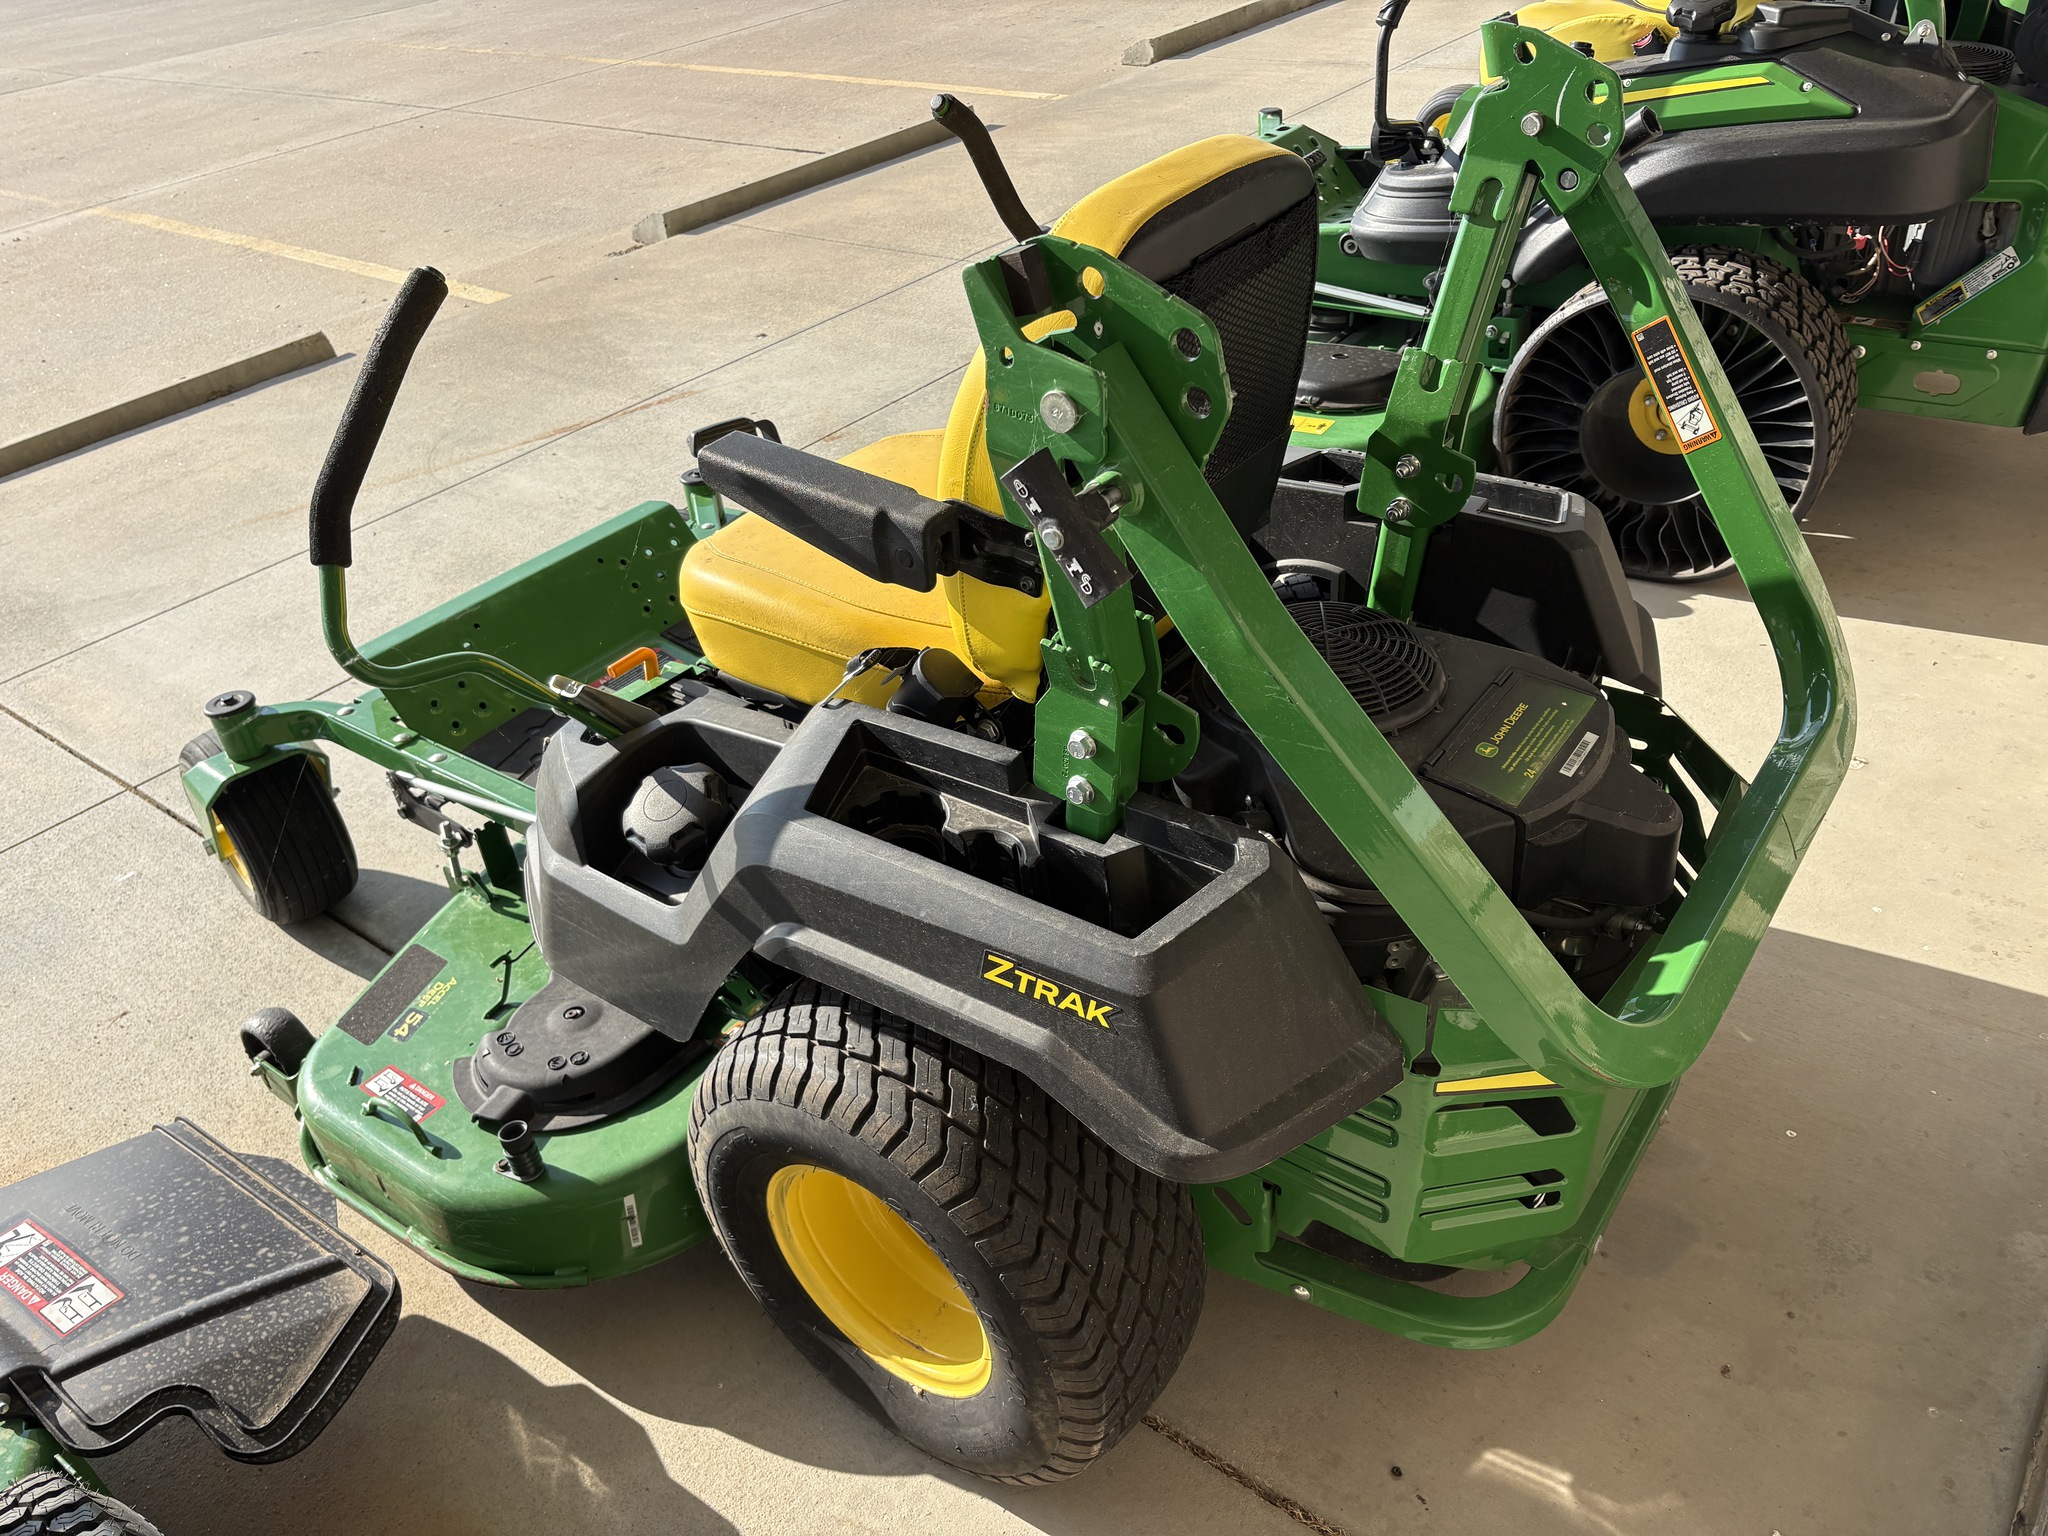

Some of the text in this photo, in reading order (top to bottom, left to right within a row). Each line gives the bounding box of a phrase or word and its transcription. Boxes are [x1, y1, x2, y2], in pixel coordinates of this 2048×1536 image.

[1686, 392, 1700, 403] AVOID
[1683, 434, 1712, 451] WARNING
[1490, 724, 1512, 744] JOHN
[1504, 702, 1529, 726] DEERE
[1523, 767, 1537, 779] 24
[418, 981, 444, 1007] DEEP
[428, 977, 457, 1006] ACCEL
[983, 954, 1114, 1029] ZTRAK
[394, 1012, 423, 1037] 54
[414, 1085, 436, 1101] DANGER
[101, 1229, 127, 1250] NOT
[120, 1244, 143, 1262] DO
[0, 1271, 34, 1304] DANGER
